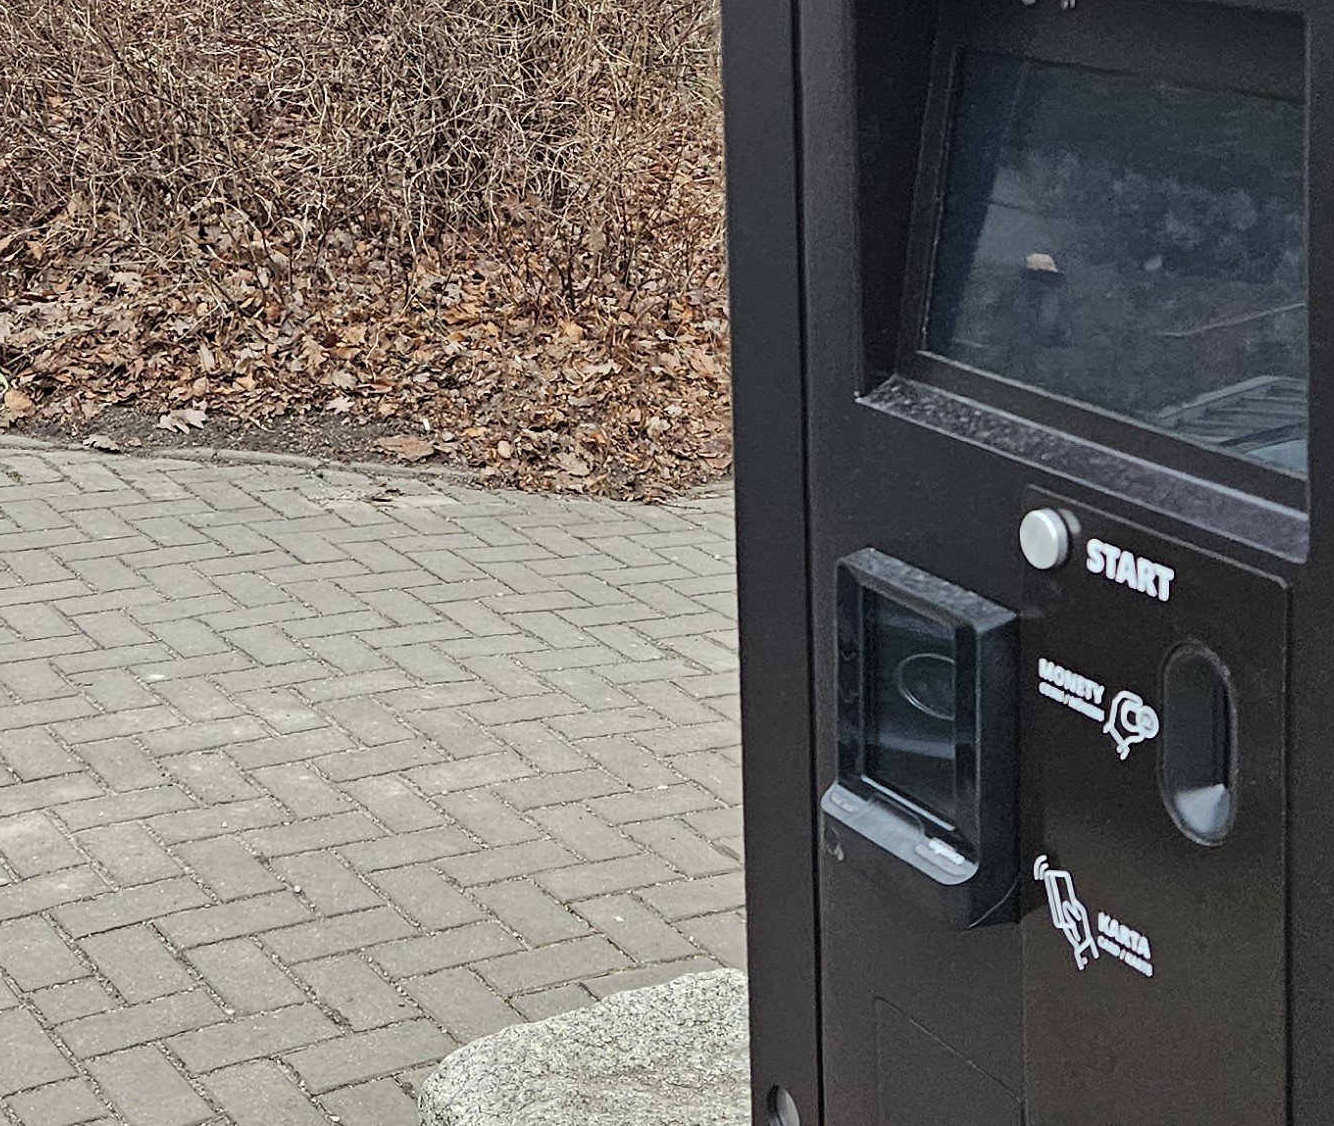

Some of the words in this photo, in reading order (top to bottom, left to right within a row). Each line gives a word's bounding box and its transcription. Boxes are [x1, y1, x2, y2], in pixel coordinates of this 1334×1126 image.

[1086, 539, 1174, 601] START
[1038, 658, 1105, 704] MONETY
[1098, 912, 1151, 959] KARTA
